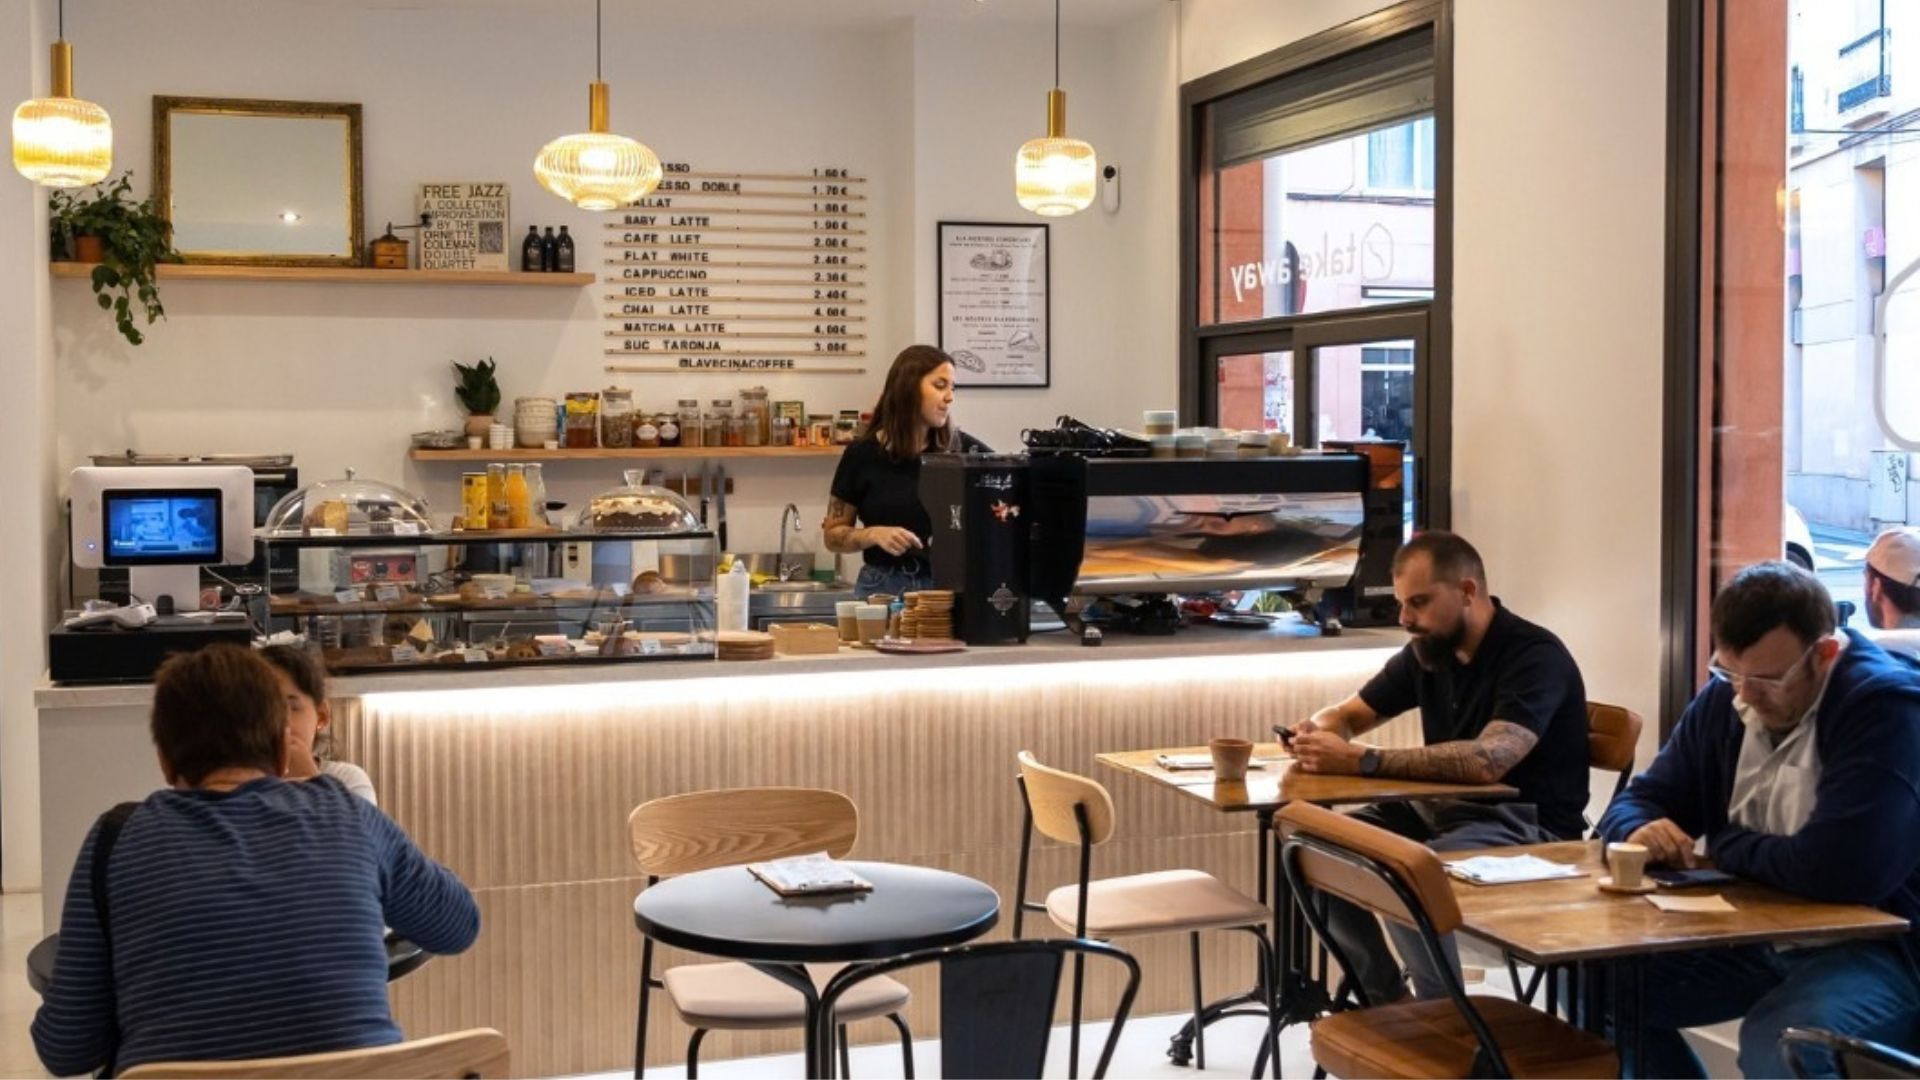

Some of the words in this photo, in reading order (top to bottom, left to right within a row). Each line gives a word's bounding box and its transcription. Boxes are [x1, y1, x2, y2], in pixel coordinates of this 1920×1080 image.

[424, 185, 461, 198] FREE
[468, 184, 504, 198] JAZZ
[702, 182, 741, 192] DOBLE
[424, 200, 431, 209] A
[438, 200, 502, 210] COLLECTIVE
[430, 210, 504, 219] PROVISATION
[437, 220, 450, 229] BY
[455, 220, 475, 229] THE
[624, 216, 656, 226] BABY
[671, 217, 710, 227] LATTE
[624, 234, 658, 244] CAFE
[671, 234, 701, 244] LLET
[424, 240, 476, 249] COLEMAN
[424, 250, 475, 259] DOUBLE
[624, 252, 658, 262] FLAT
[670, 252, 709, 263] WHITE
[424, 260, 476, 269] QUARTET
[623, 269, 707, 280] CAPPUCCINO
[625, 287, 656, 297] ICED
[669, 287, 709, 297] LATTE
[623, 305, 654, 315] CHAI
[670, 305, 710, 316] LATTE
[624, 323, 675, 333] MATCHA
[685, 323, 725, 333] LATTE
[624, 340, 650, 350] SUC
[663, 340, 721, 351] TARONJA
[679, 358, 795, 369] @LAVECINACOFFEE
